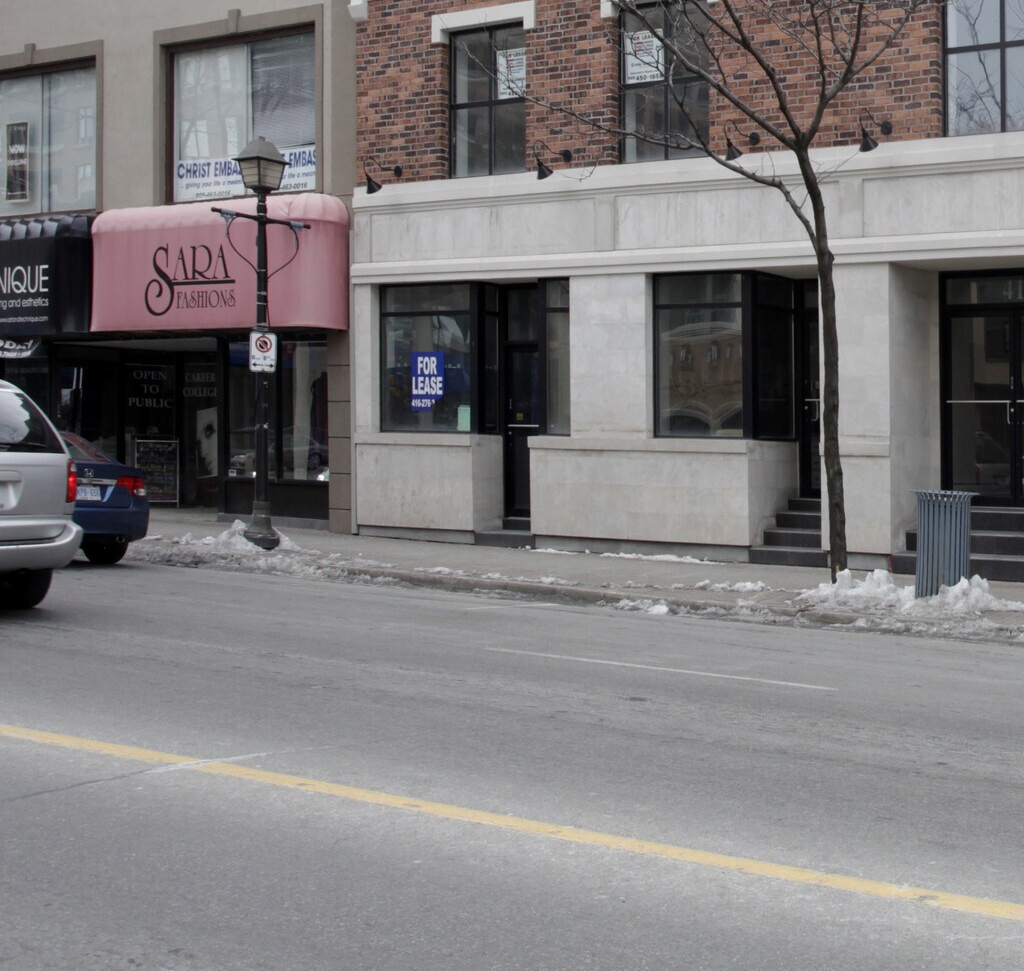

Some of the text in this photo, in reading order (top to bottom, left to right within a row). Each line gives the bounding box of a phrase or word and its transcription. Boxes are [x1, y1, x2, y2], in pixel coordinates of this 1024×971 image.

[9, 144, 26, 155] NOW
[177, 162, 211, 179] CHRIST
[145, 243, 231, 316] SARA
[1002, 278, 1024, 300] 41
[8, 298, 20, 308] and
[21, 296, 49, 307] esthetics
[176, 289, 236, 309] FASHIONS
[417, 356, 438, 375] FOR
[133, 370, 167, 381] OPEN
[185, 372, 216, 382] CAREER
[143, 384, 160, 394] TO
[412, 376, 444, 395] LEASE
[183, 387, 218, 397] COLLEGE
[128, 397, 173, 409] PUBLIC
